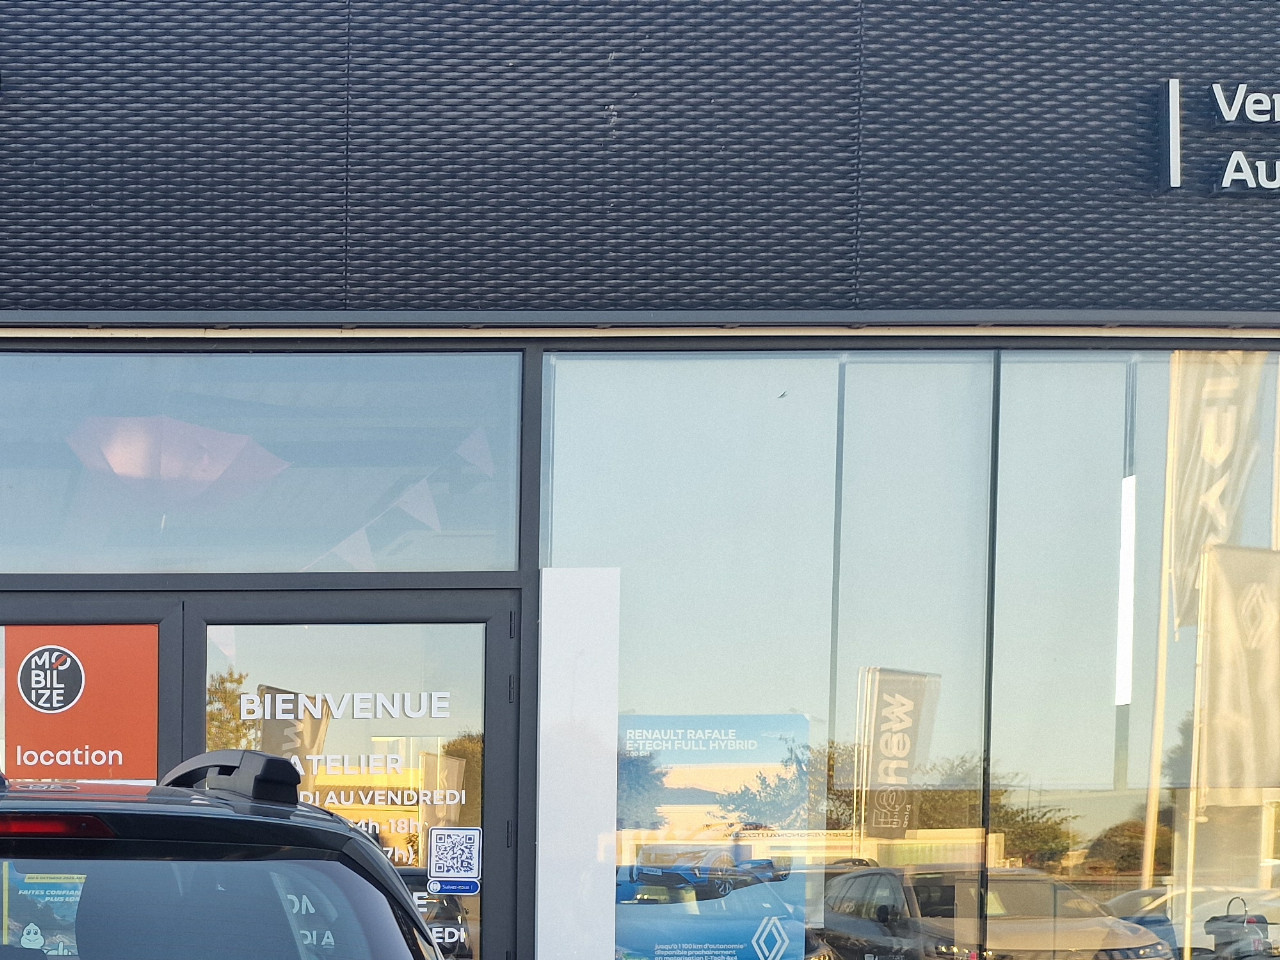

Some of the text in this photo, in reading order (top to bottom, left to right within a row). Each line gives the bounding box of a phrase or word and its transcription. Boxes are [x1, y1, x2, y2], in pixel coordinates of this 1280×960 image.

[240, 692, 451, 720] BIENVENUE
[626, 729, 736, 740] RENAULT RAFALE
[626, 740, 758, 750] E-TECH FULL HYBRID
[16, 745, 123, 765] location
[324, 791, 354, 805] AU
[358, 790, 466, 805] VENDREDI
